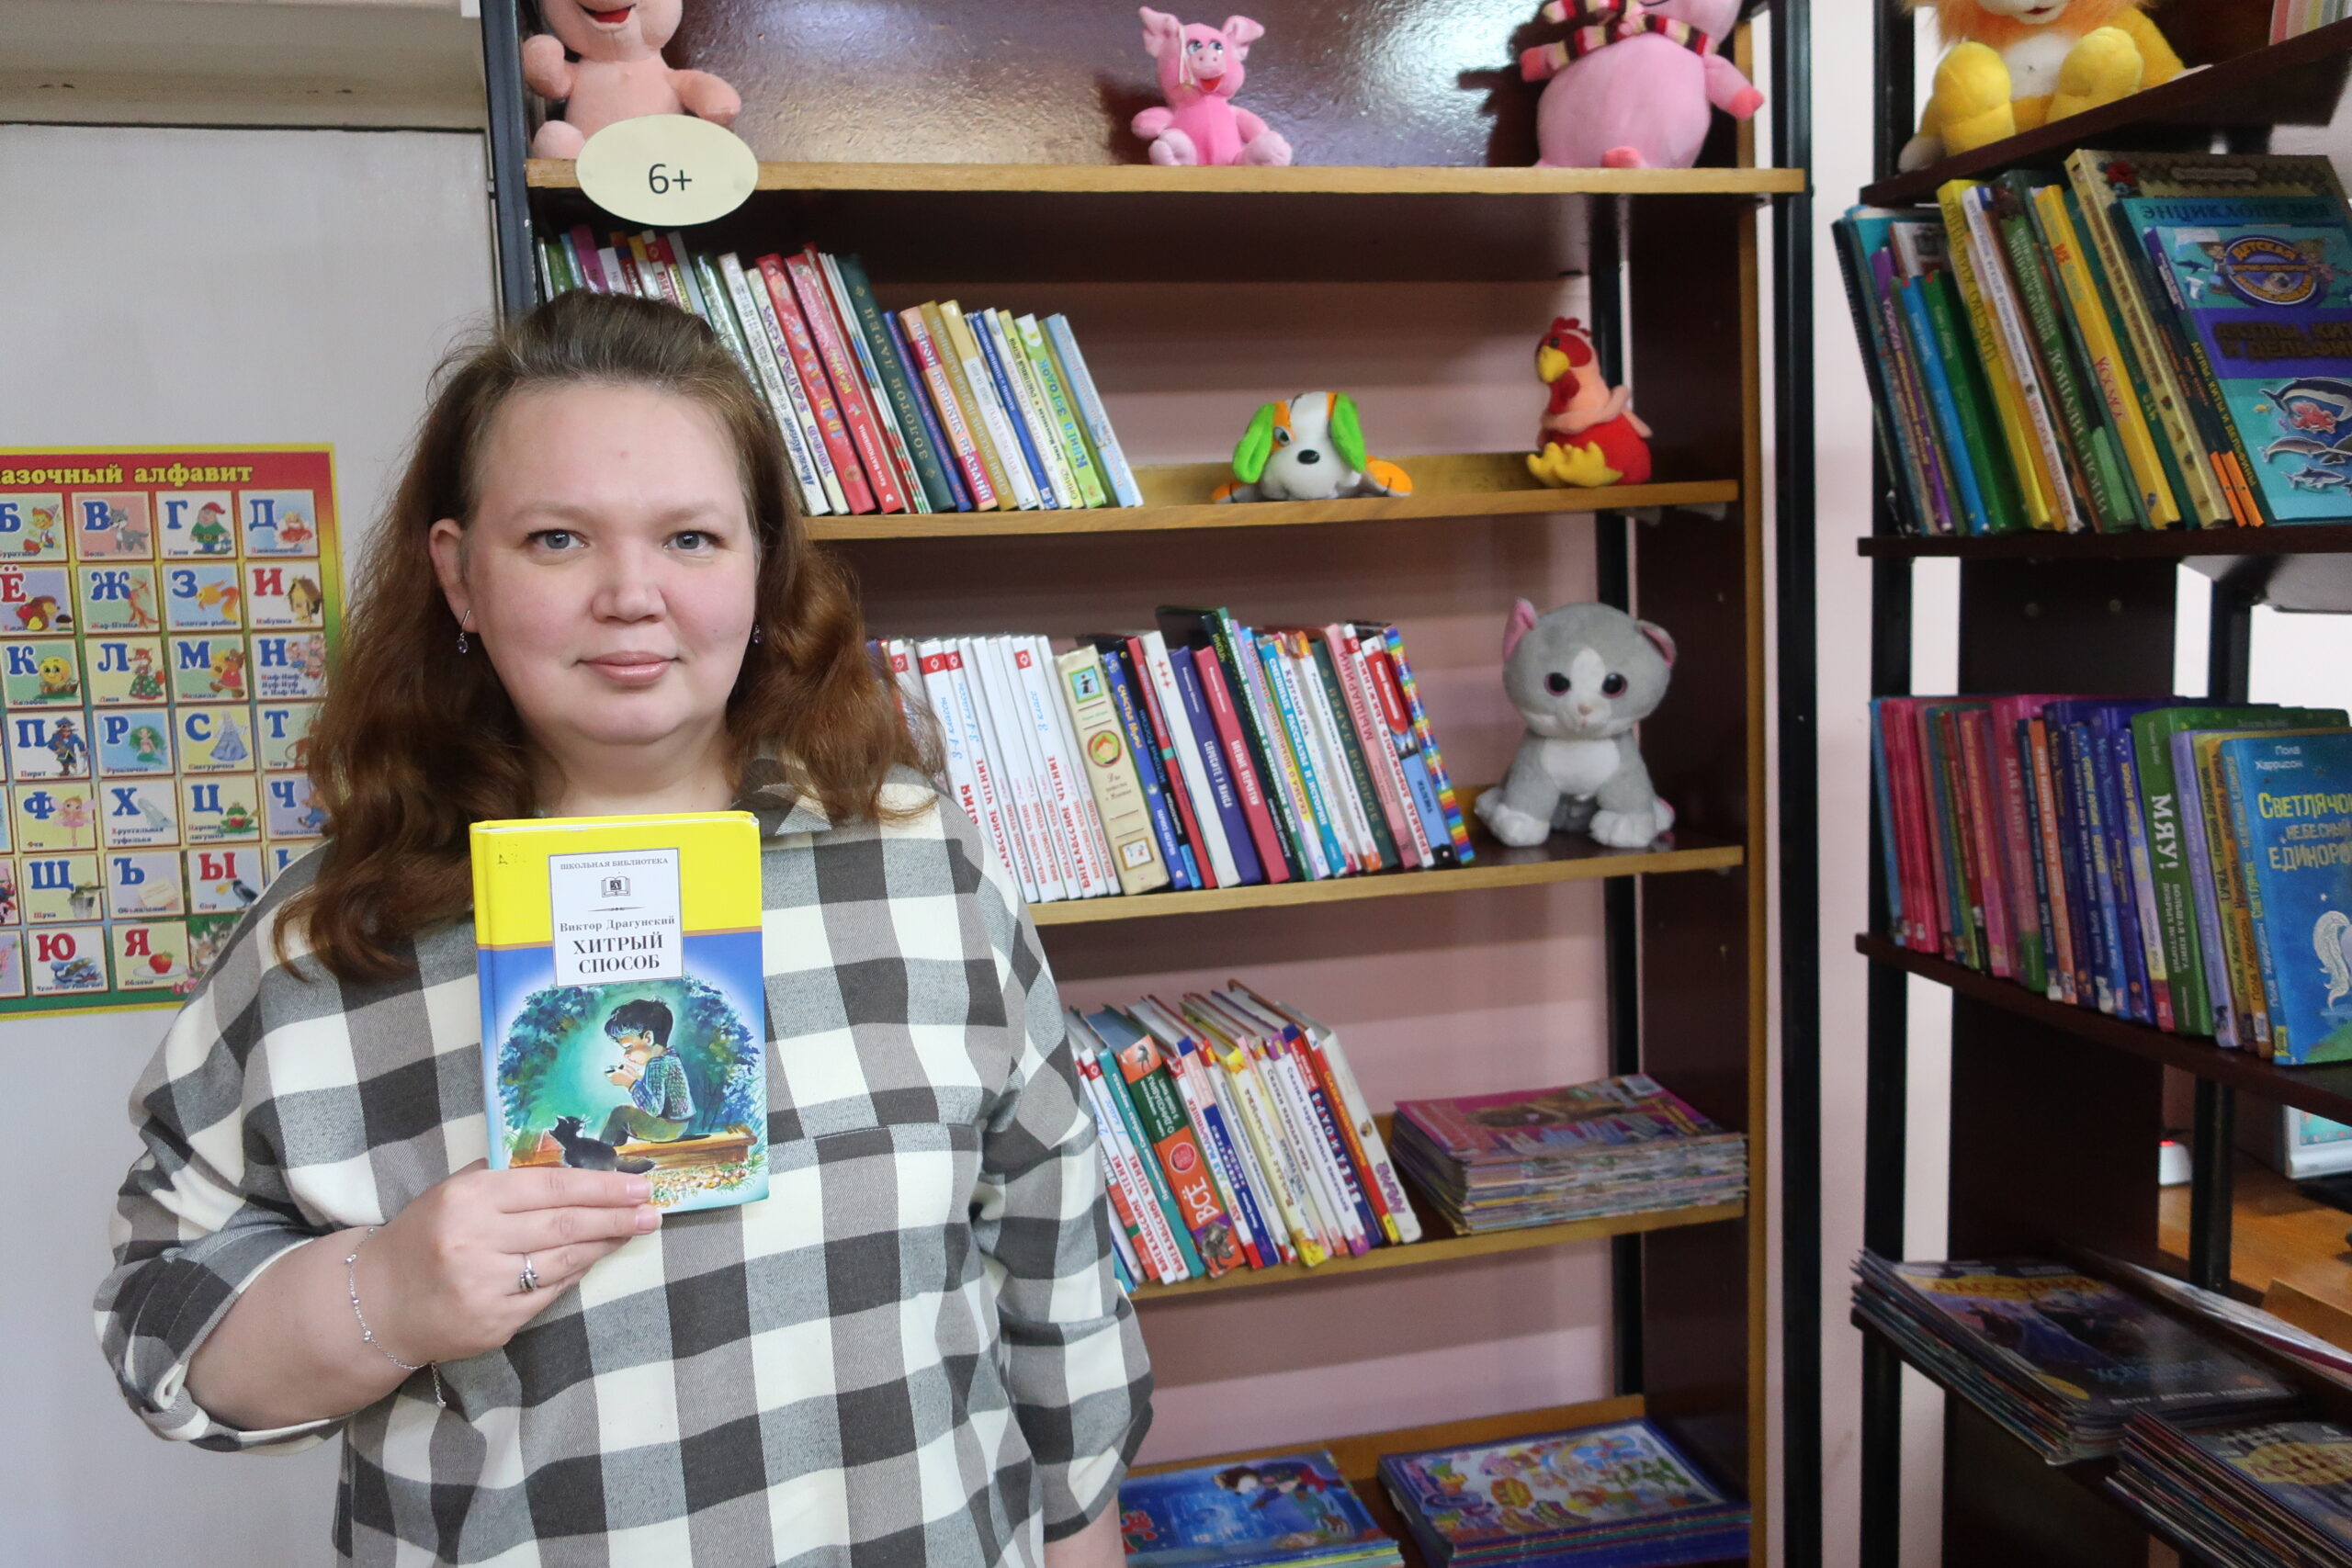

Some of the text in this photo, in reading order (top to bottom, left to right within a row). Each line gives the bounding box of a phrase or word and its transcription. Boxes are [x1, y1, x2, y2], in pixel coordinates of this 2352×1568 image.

[649, 164, 692, 194] 6+
[862, 305, 896, 371] ЛАРЕЦ
[889, 376, 929, 460] ЗОЛОТОЙ
[0, 462, 253, 487] азочный алфавит
[0, 503, 21, 533] Б
[83, 502, 110, 531] В
[165, 500, 188, 529] Г
[248, 499, 277, 531] Д
[1, 566, 27, 602] Ё
[91, 570, 130, 600] Ж
[172, 570, 198, 598] З
[253, 569, 283, 595] И
[6, 646, 39, 675] К
[97, 643, 130, 671] Л
[177, 641, 211, 670] М
[259, 639, 288, 667] Н
[1027, 689, 1045, 721] класс
[1283, 668, 1310, 736] Круглый год
[1338, 649, 1374, 741] МЫШАРИКИ
[1357, 659, 1385, 726] ДВИЖЕНИЯ
[104, 716, 129, 744] Р
[186, 713, 211, 741] С
[265, 710, 288, 738] Т
[938, 695, 956, 735] классы
[16, 718, 47, 748] П
[1268, 657, 1328, 826] СМЕШНЫЕ РАССКАЗЫ И ИСТОРИИ
[1204, 739, 1223, 776] СПРОСИТЕ
[1215, 776, 1225, 784] У
[1327, 685, 1379, 823] ЗОЛОТОЙ ЛАРЕЦ
[1381, 728, 1410, 799] ДОРОЖНОГО
[2275, 745, 2301, 755] Пола
[973, 757, 995, 805] ЧТЕНИЕ
[1230, 739, 1260, 806] БОЕВЫЕ ПЕРЧАТКИ
[2255, 760, 2304, 772] Харрисон
[24, 792, 55, 819] Ф
[111, 787, 141, 816] Х
[191, 784, 223, 815] Ц
[271, 781, 296, 807] Ч
[2257, 791, 2352, 818] СВЕТЛЯЧО
[1046, 754, 1092, 888] ВНЕКЛАССНОЕ ЧТЕНИЕ
[2149, 793, 2181, 870] МЯУ!
[114, 857, 144, 886] Ъ
[198, 852, 237, 881] Ы
[560, 857, 669, 871] ШКОЛЬНАЯ БИБЛИОТЕКА
[2267, 841, 2352, 872] ЕДИНОРО
[29, 861, 74, 891] Щ
[560, 915, 675, 934] Виктор Драгунский
[2161, 882, 2182, 973] ДОБРЫХ ИСТОРИЙ
[2170, 883, 2190, 969] БОЛЬШАЯ КНИГА
[37, 932, 76, 962] Ю
[125, 929, 151, 956] Я
[572, 931, 663, 955] ХИТРЫЙ
[579, 953, 660, 975] СПОСОБ
[1145, 1072, 1176, 1134] О ДИНОЗАВРАХ
[1185, 1096, 1217, 1161] МАЛЬЧИШЕК
[1211, 1160, 1227, 1183] ДЛЯ
[1110, 1153, 1169, 1273] ВНЕКЛАССНОЕ ЧТЕНИЕ
[1126, 1153, 1185, 1274] ВНЕКЛАССНОЕ ЧТЕНИЕ
[1178, 1174, 1220, 1225] ВСЁ
[1220, 1184, 1242, 1223] АЗБУКА
